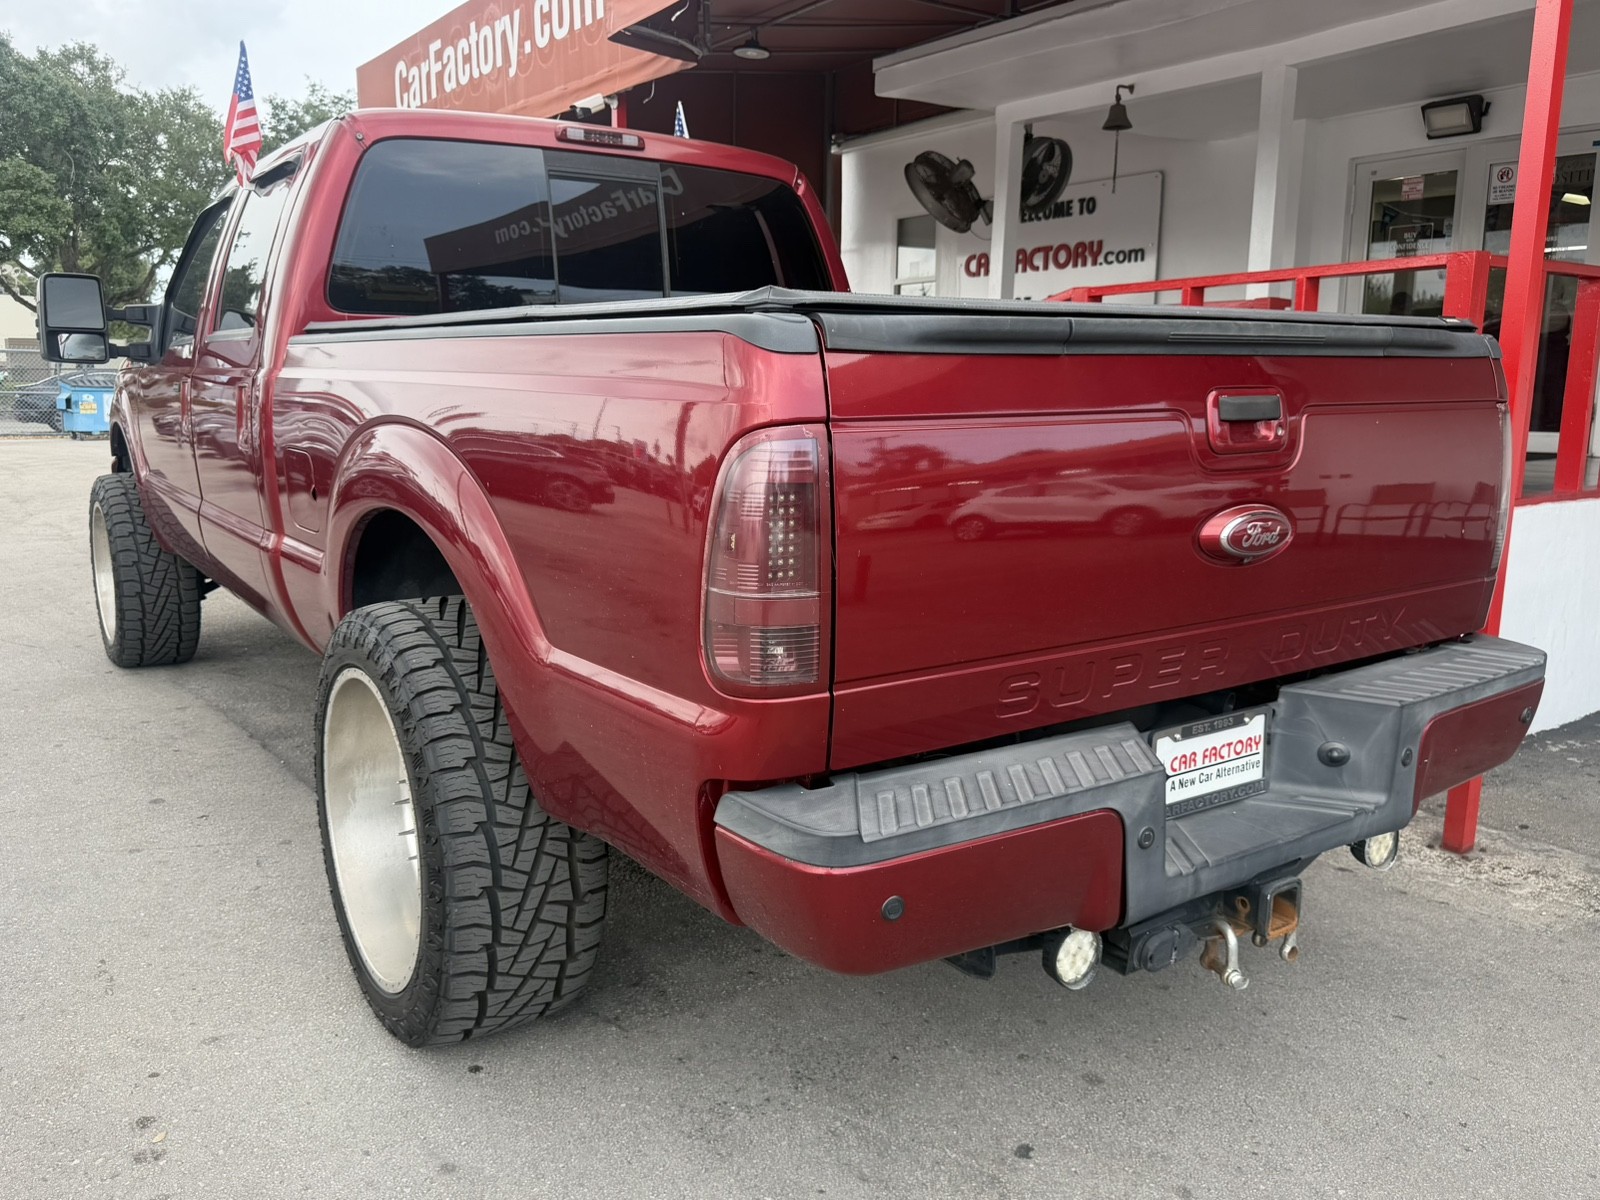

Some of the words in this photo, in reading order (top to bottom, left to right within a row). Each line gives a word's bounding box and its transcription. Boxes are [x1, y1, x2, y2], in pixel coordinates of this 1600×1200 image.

[1020, 199, 1074, 223] ELCOME
[1078, 197, 1096, 216] TO
[964, 253, 990, 278] CA
[1015, 239, 1145, 274] ACTORY.com
[1241, 521, 1281, 548] Ford
[994, 638, 1231, 718] SUPER
[1270, 605, 1407, 664] DUTY
[1192, 723, 1211, 735] EST.
[1213, 717, 1234, 729] 1993
[1170, 751, 1198, 773] CAR
[1201, 734, 1262, 765] FACTORY
[1169, 780, 1176, 792] A
[1178, 777, 1196, 790] New
[1198, 772, 1213, 784] Car
[1215, 759, 1261, 779] Alternative
[1165, 780, 1265, 816] ARFACTORY.COM
